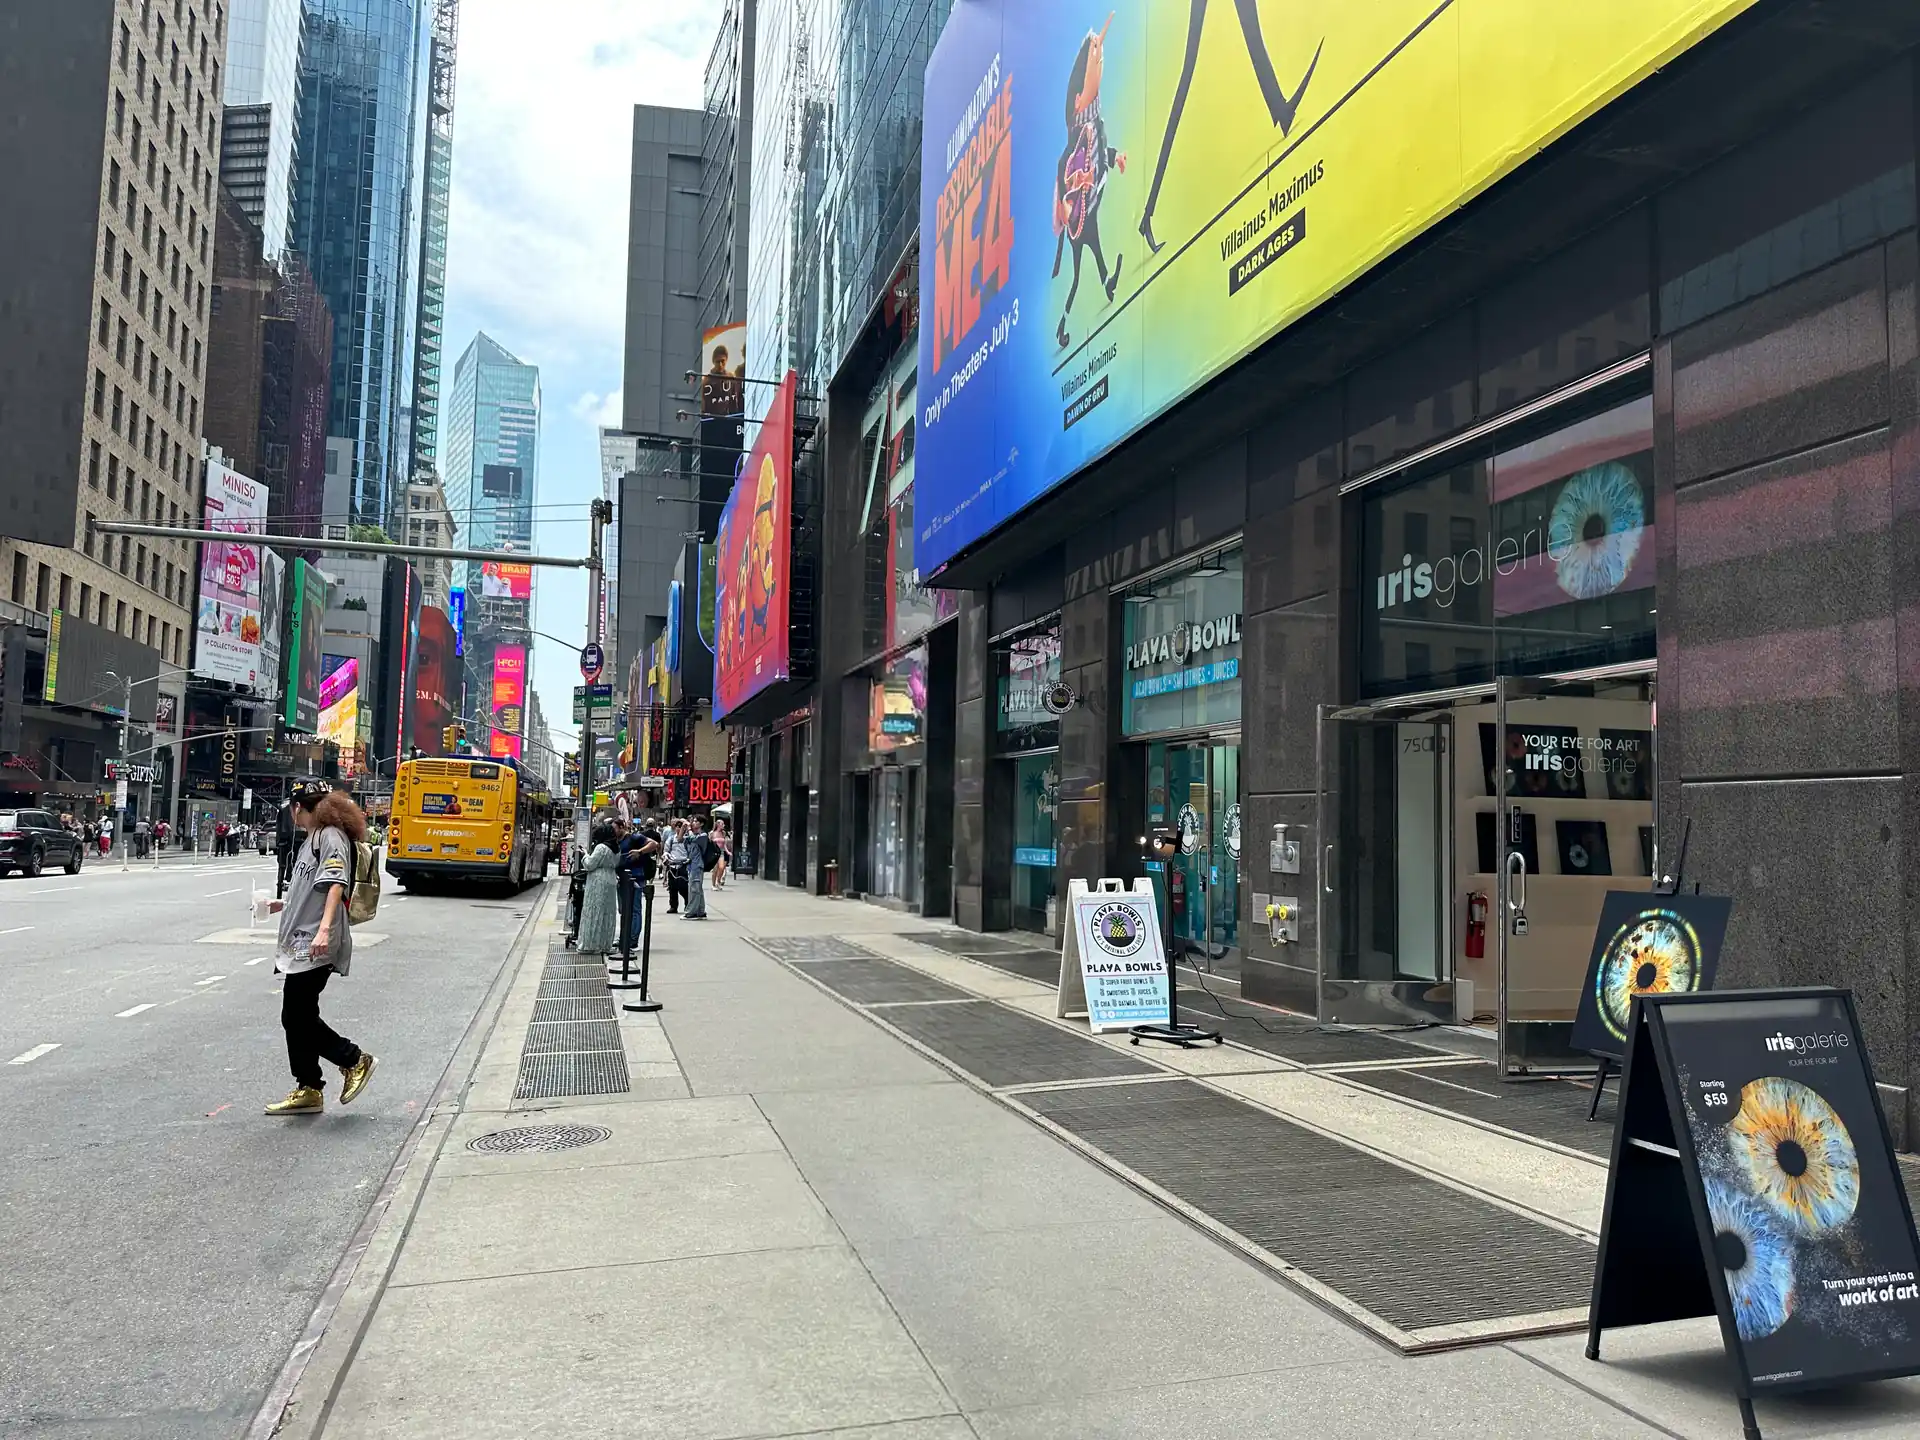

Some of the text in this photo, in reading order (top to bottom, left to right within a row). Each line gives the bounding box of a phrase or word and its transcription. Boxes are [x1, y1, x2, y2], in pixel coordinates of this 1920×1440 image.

[946, 52, 1000, 173] ILLUMINATION'S
[935, 71, 1013, 246] DESPICABLE
[1221, 159, 1324, 262] Villainus Maximus
[1238, 224, 1295, 282] DARK AGES
[924, 297, 1020, 429] Only In Theaters July 3
[1061, 342, 1117, 402] Villainus Minimus
[711, 394, 737, 404] PART
[1066, 383, 1105, 424] DAWN OF GRU
[222, 472, 256, 500] MINISO
[237, 497, 252, 509] SQUARE
[227, 563, 241, 575] MINI
[501, 565, 529, 574] BRAIN
[210, 641, 238, 653] COLLECTION
[239, 646, 253, 656] STORE
[1126, 613, 1242, 670] PLAYA BOWL
[1173, 667, 1206, 689] SMOOTHIES
[1213, 660, 1235, 681] JUICES
[1000, 690, 1026, 713] PLAYA
[222, 714, 236, 775] LAGOS
[1522, 734, 1640, 751] YOUR EYE FOR ART
[130, 764, 155, 783] GIFTS
[650, 767, 690, 776] TAVERN
[480, 784, 500, 792] 9462
[689, 778, 731, 801] BURG
[1094, 905, 1141, 927] PLAYA BOWLS
[1087, 962, 1163, 973] PLAYA BOWLS
[1788, 1059, 1804, 1067] YOUR
[1815, 1057, 1827, 1065] FOR
[1828, 1056, 1838, 1064] ART
[1699, 1080, 1725, 1089] Starting
[1703, 1092, 1728, 1107] $59
[1822, 1271, 1915, 1290] Turn your eyes into a
[1838, 1282, 1920, 1307] work of art
